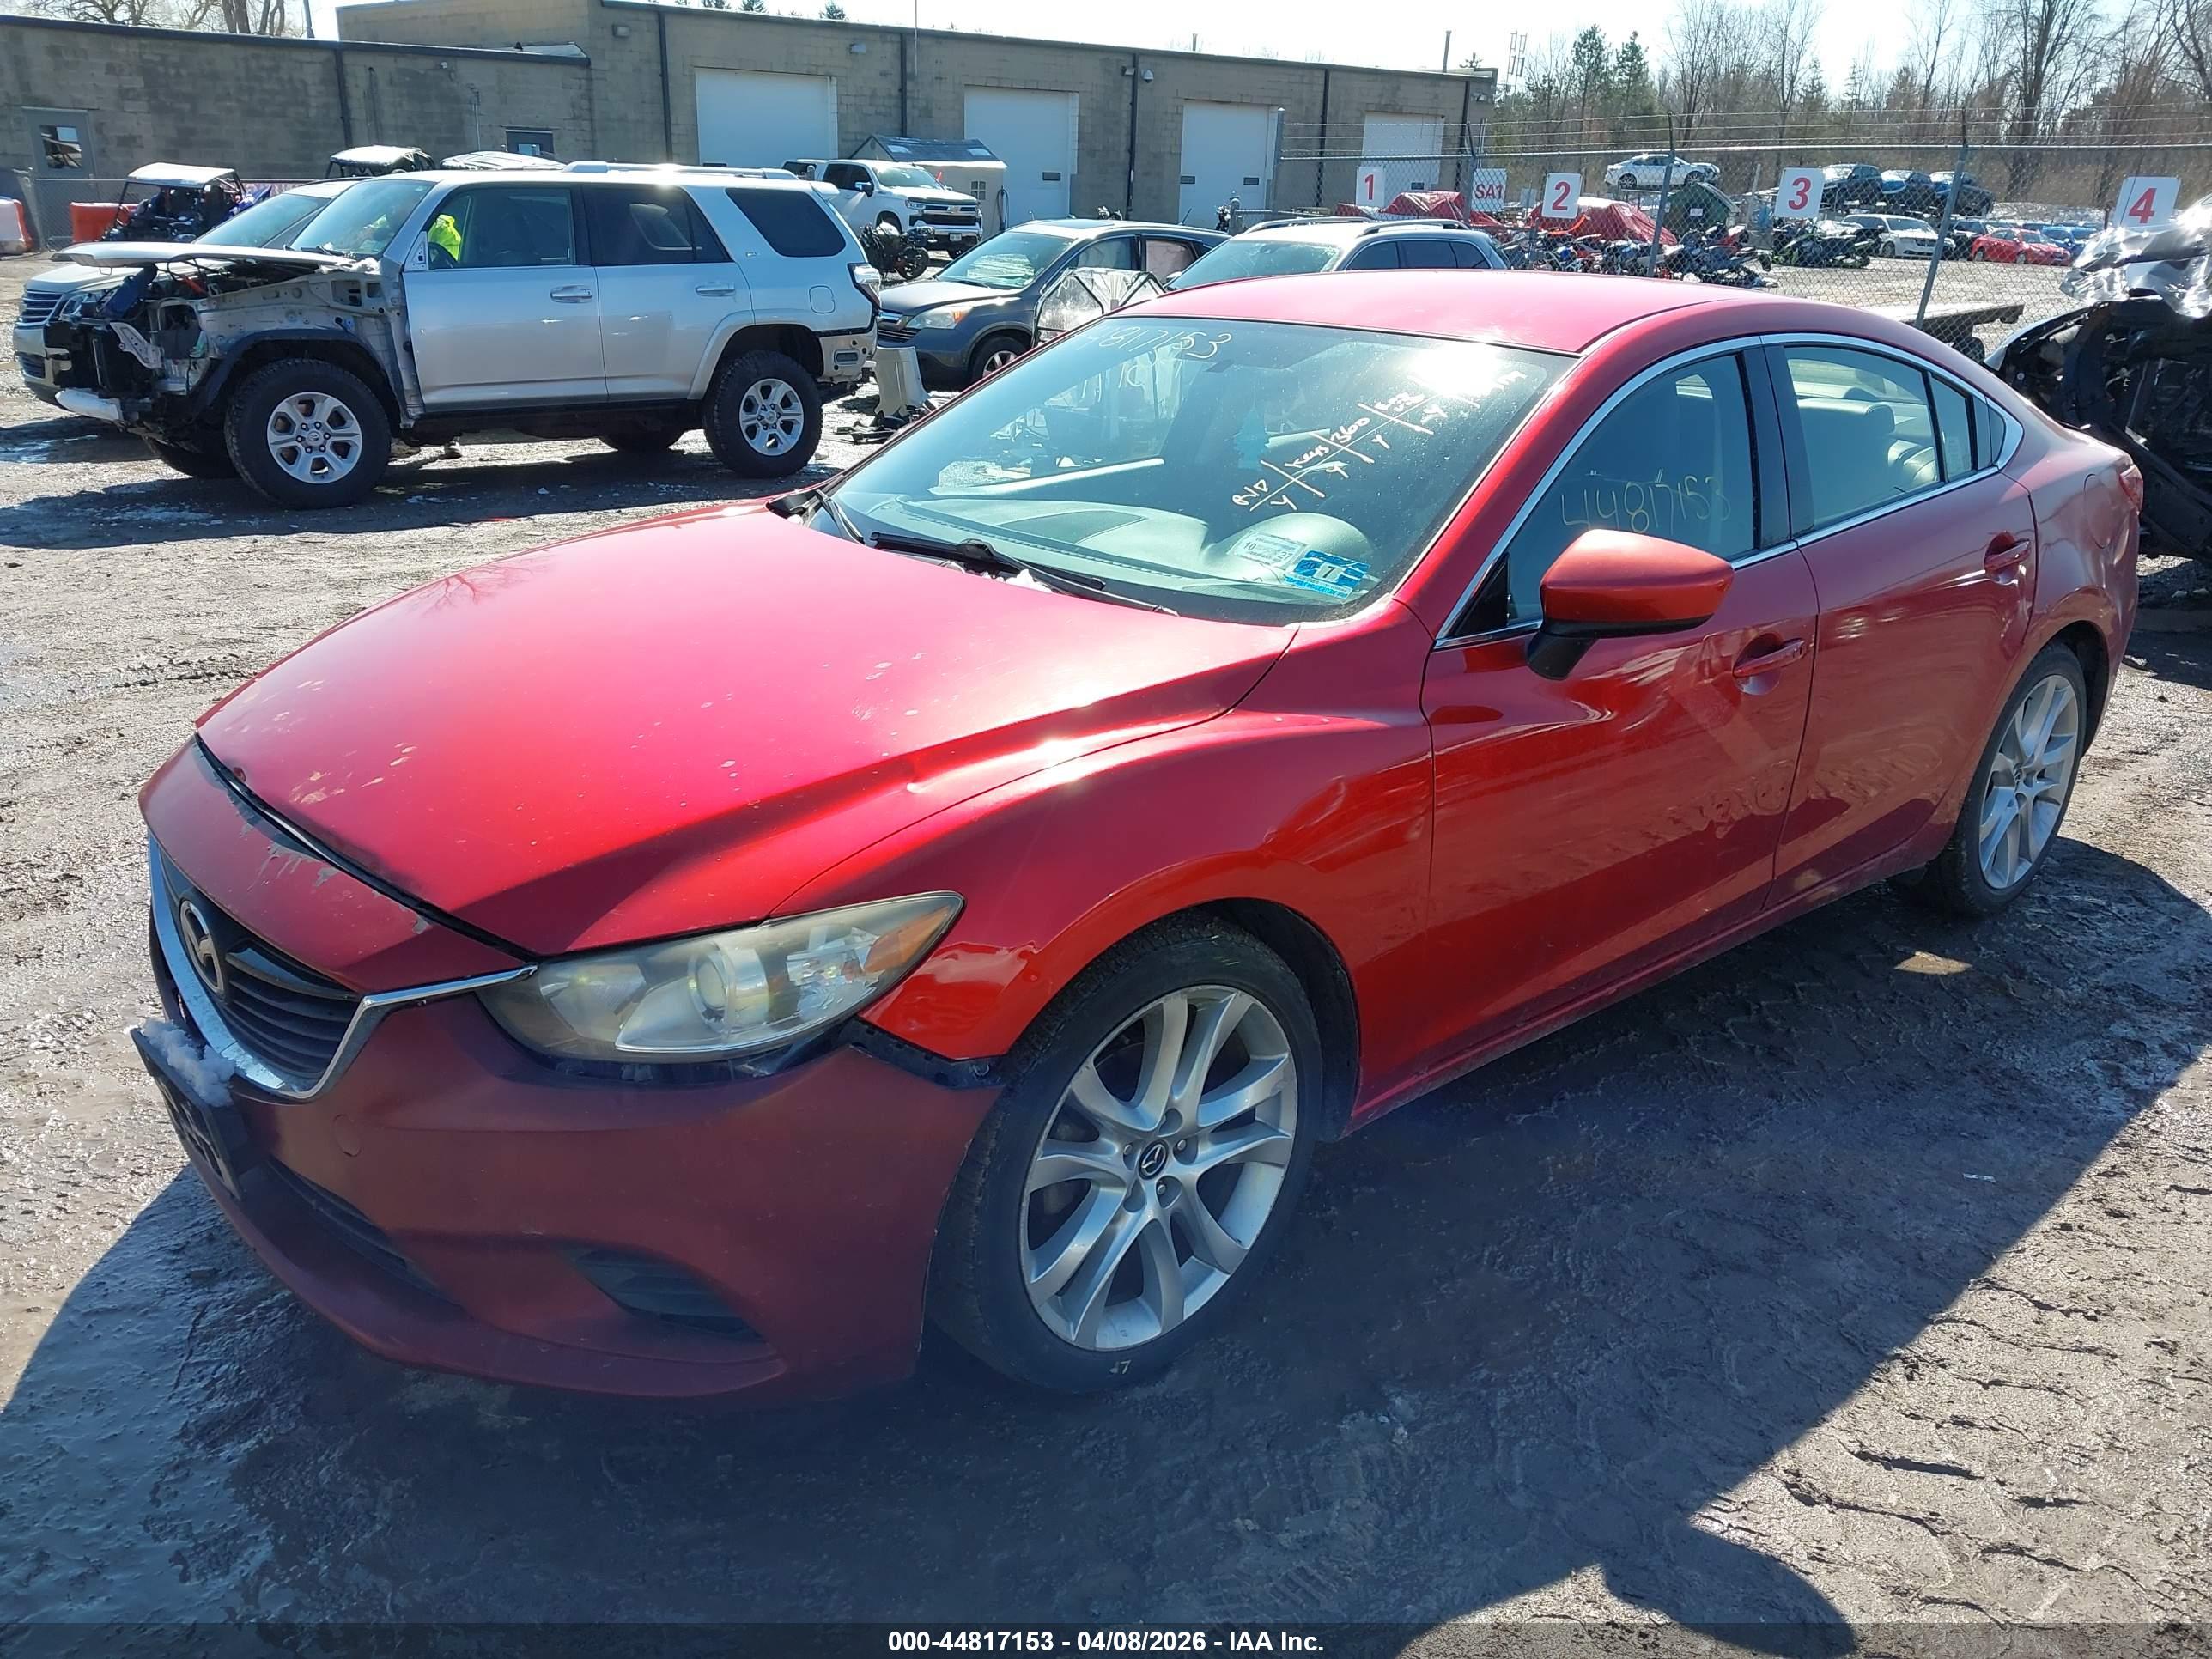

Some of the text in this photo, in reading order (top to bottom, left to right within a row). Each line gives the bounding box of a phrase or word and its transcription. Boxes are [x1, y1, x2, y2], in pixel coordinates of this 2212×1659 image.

[1364, 173, 1375, 200] 1
[1474, 183, 1503, 200] SA1
[1552, 181, 1571, 211] 2
[1788, 177, 1812, 210] 3
[2128, 187, 2158, 224] 4
[1331, 416, 1370, 444] 360
[1560, 475, 1732, 537] 44817153
